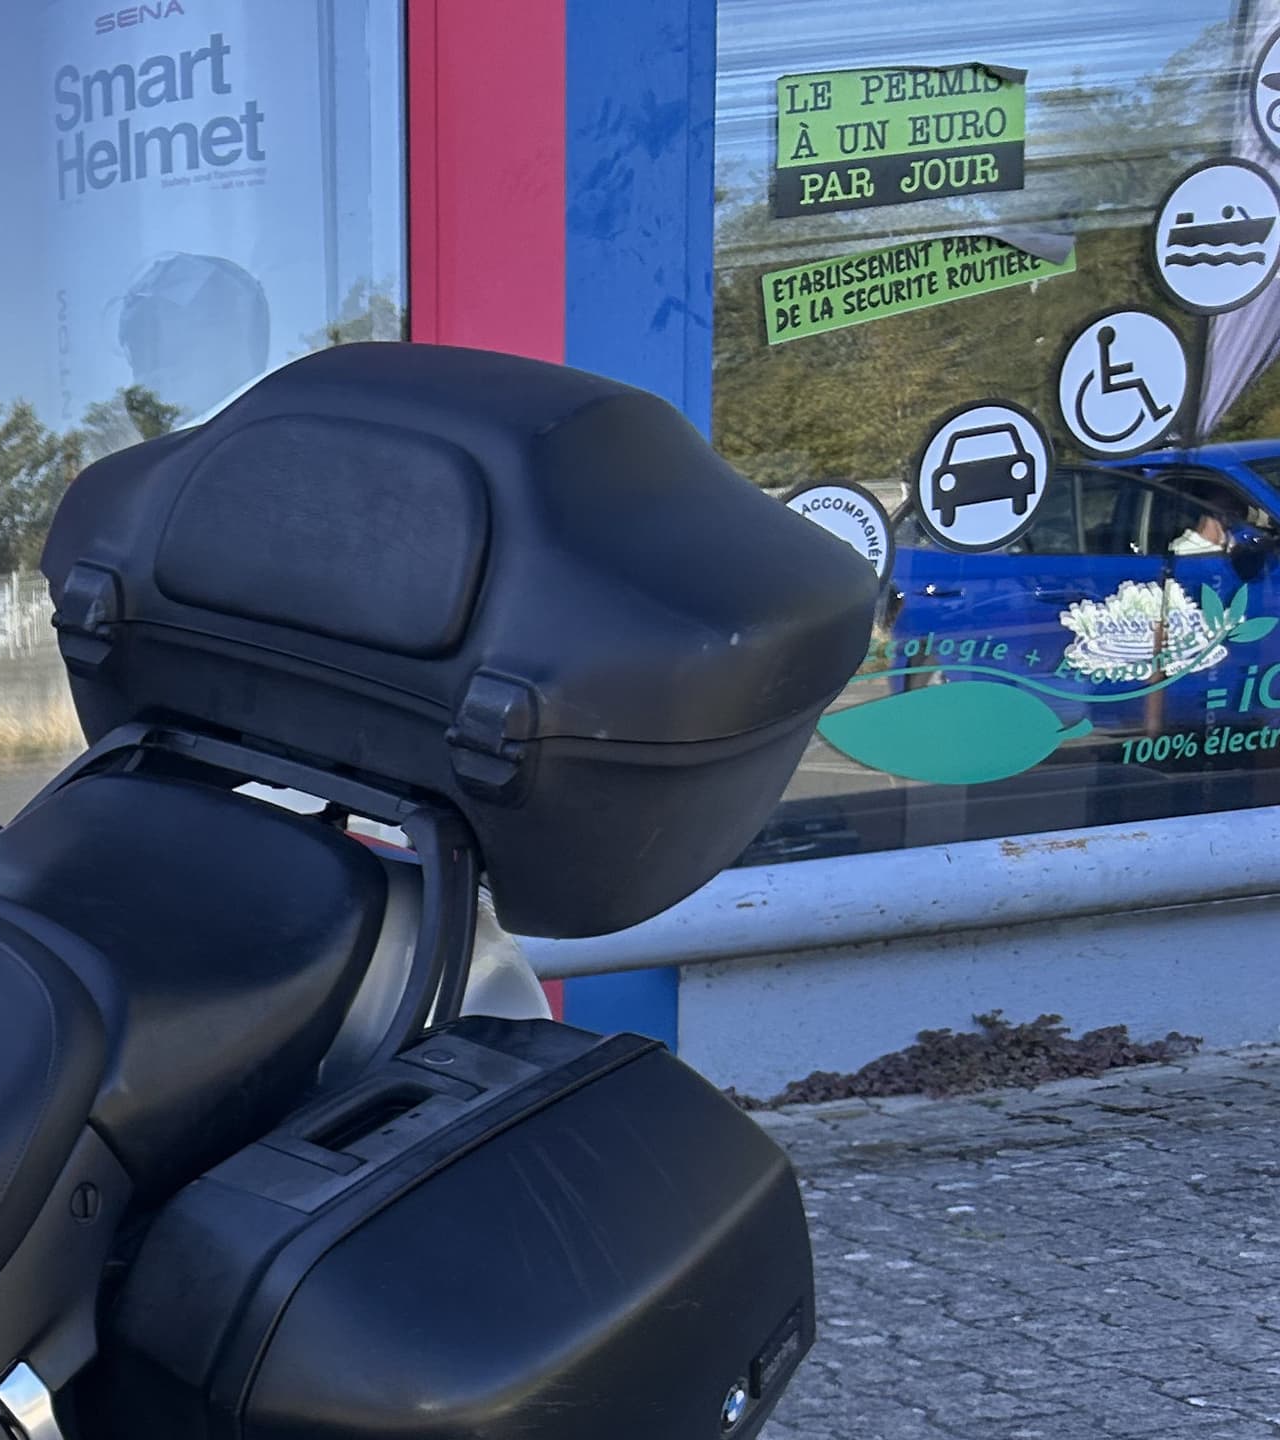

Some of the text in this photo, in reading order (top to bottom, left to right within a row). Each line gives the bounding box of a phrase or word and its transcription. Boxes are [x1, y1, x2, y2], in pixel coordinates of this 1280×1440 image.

[94, 0, 185, 35] SENA
[54, 32, 232, 132] Smart
[785, 66, 1003, 115] LE PERMIS
[56, 100, 266, 200] Helmet
[790, 107, 1006, 160] À UN EURO
[800, 153, 999, 205] PAR JOUR
[772, 241, 933, 303] ETABLISSEMENT
[776, 307, 801, 333] DE
[810, 296, 833, 323] LA
[843, 270, 940, 315] SECURITE
[1122, 733, 1197, 764] 100%
